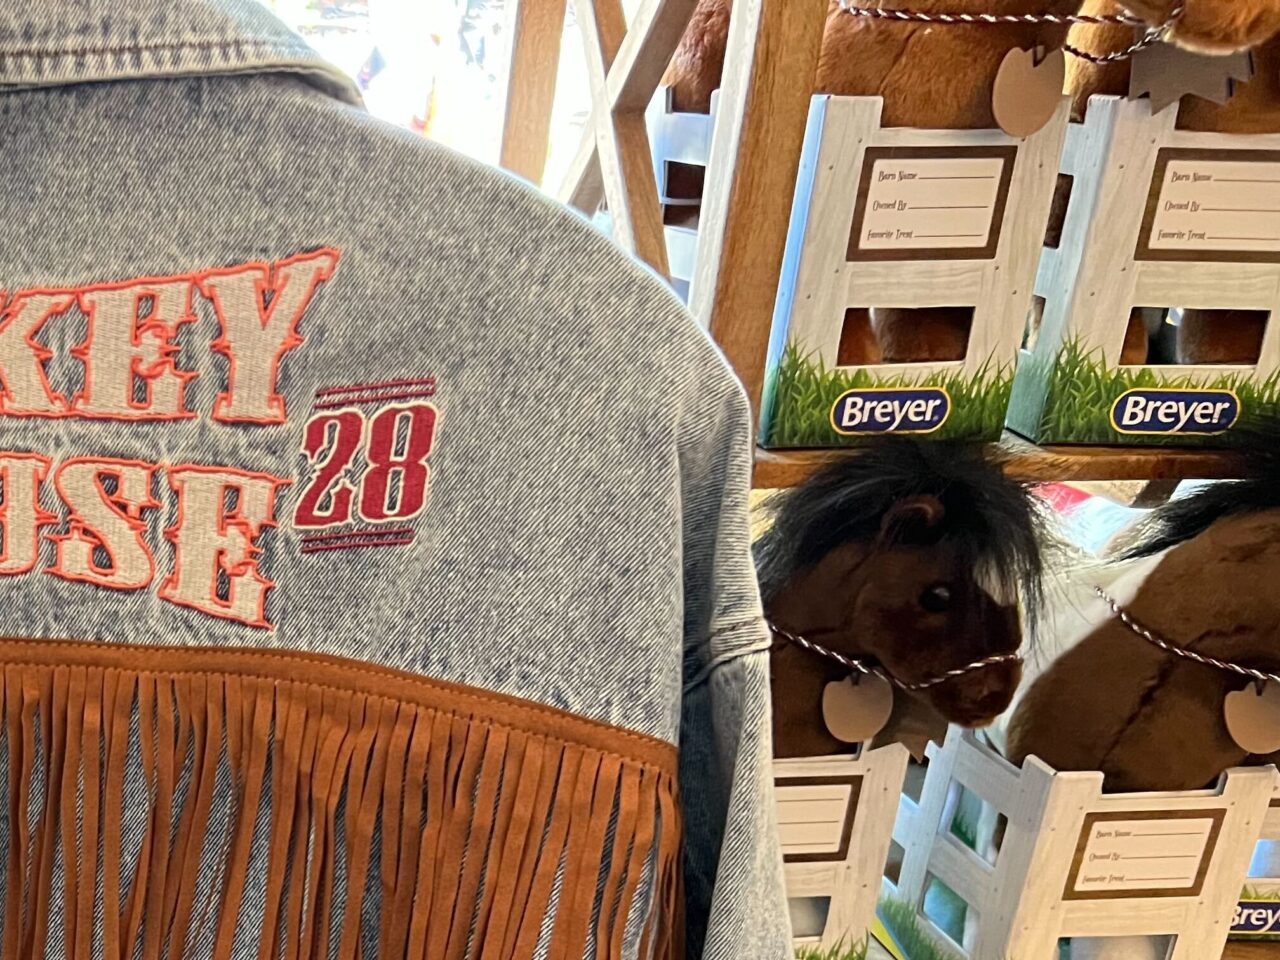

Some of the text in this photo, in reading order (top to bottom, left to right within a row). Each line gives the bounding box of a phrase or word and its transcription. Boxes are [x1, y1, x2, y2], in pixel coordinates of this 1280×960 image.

[878, 170, 918, 182] Barn Name
[1171, 171, 1213, 183] Barn Name
[873, 200, 908, 211] Owned By
[1165, 201, 1200, 212] Owned By
[867, 228, 913, 241] Favorite Treat
[1158, 230, 1206, 241] Favorite Treat
[841, 396, 942, 432] Breyer
[1121, 396, 1231, 433] Breyer
[293, 400, 438, 528] 28
